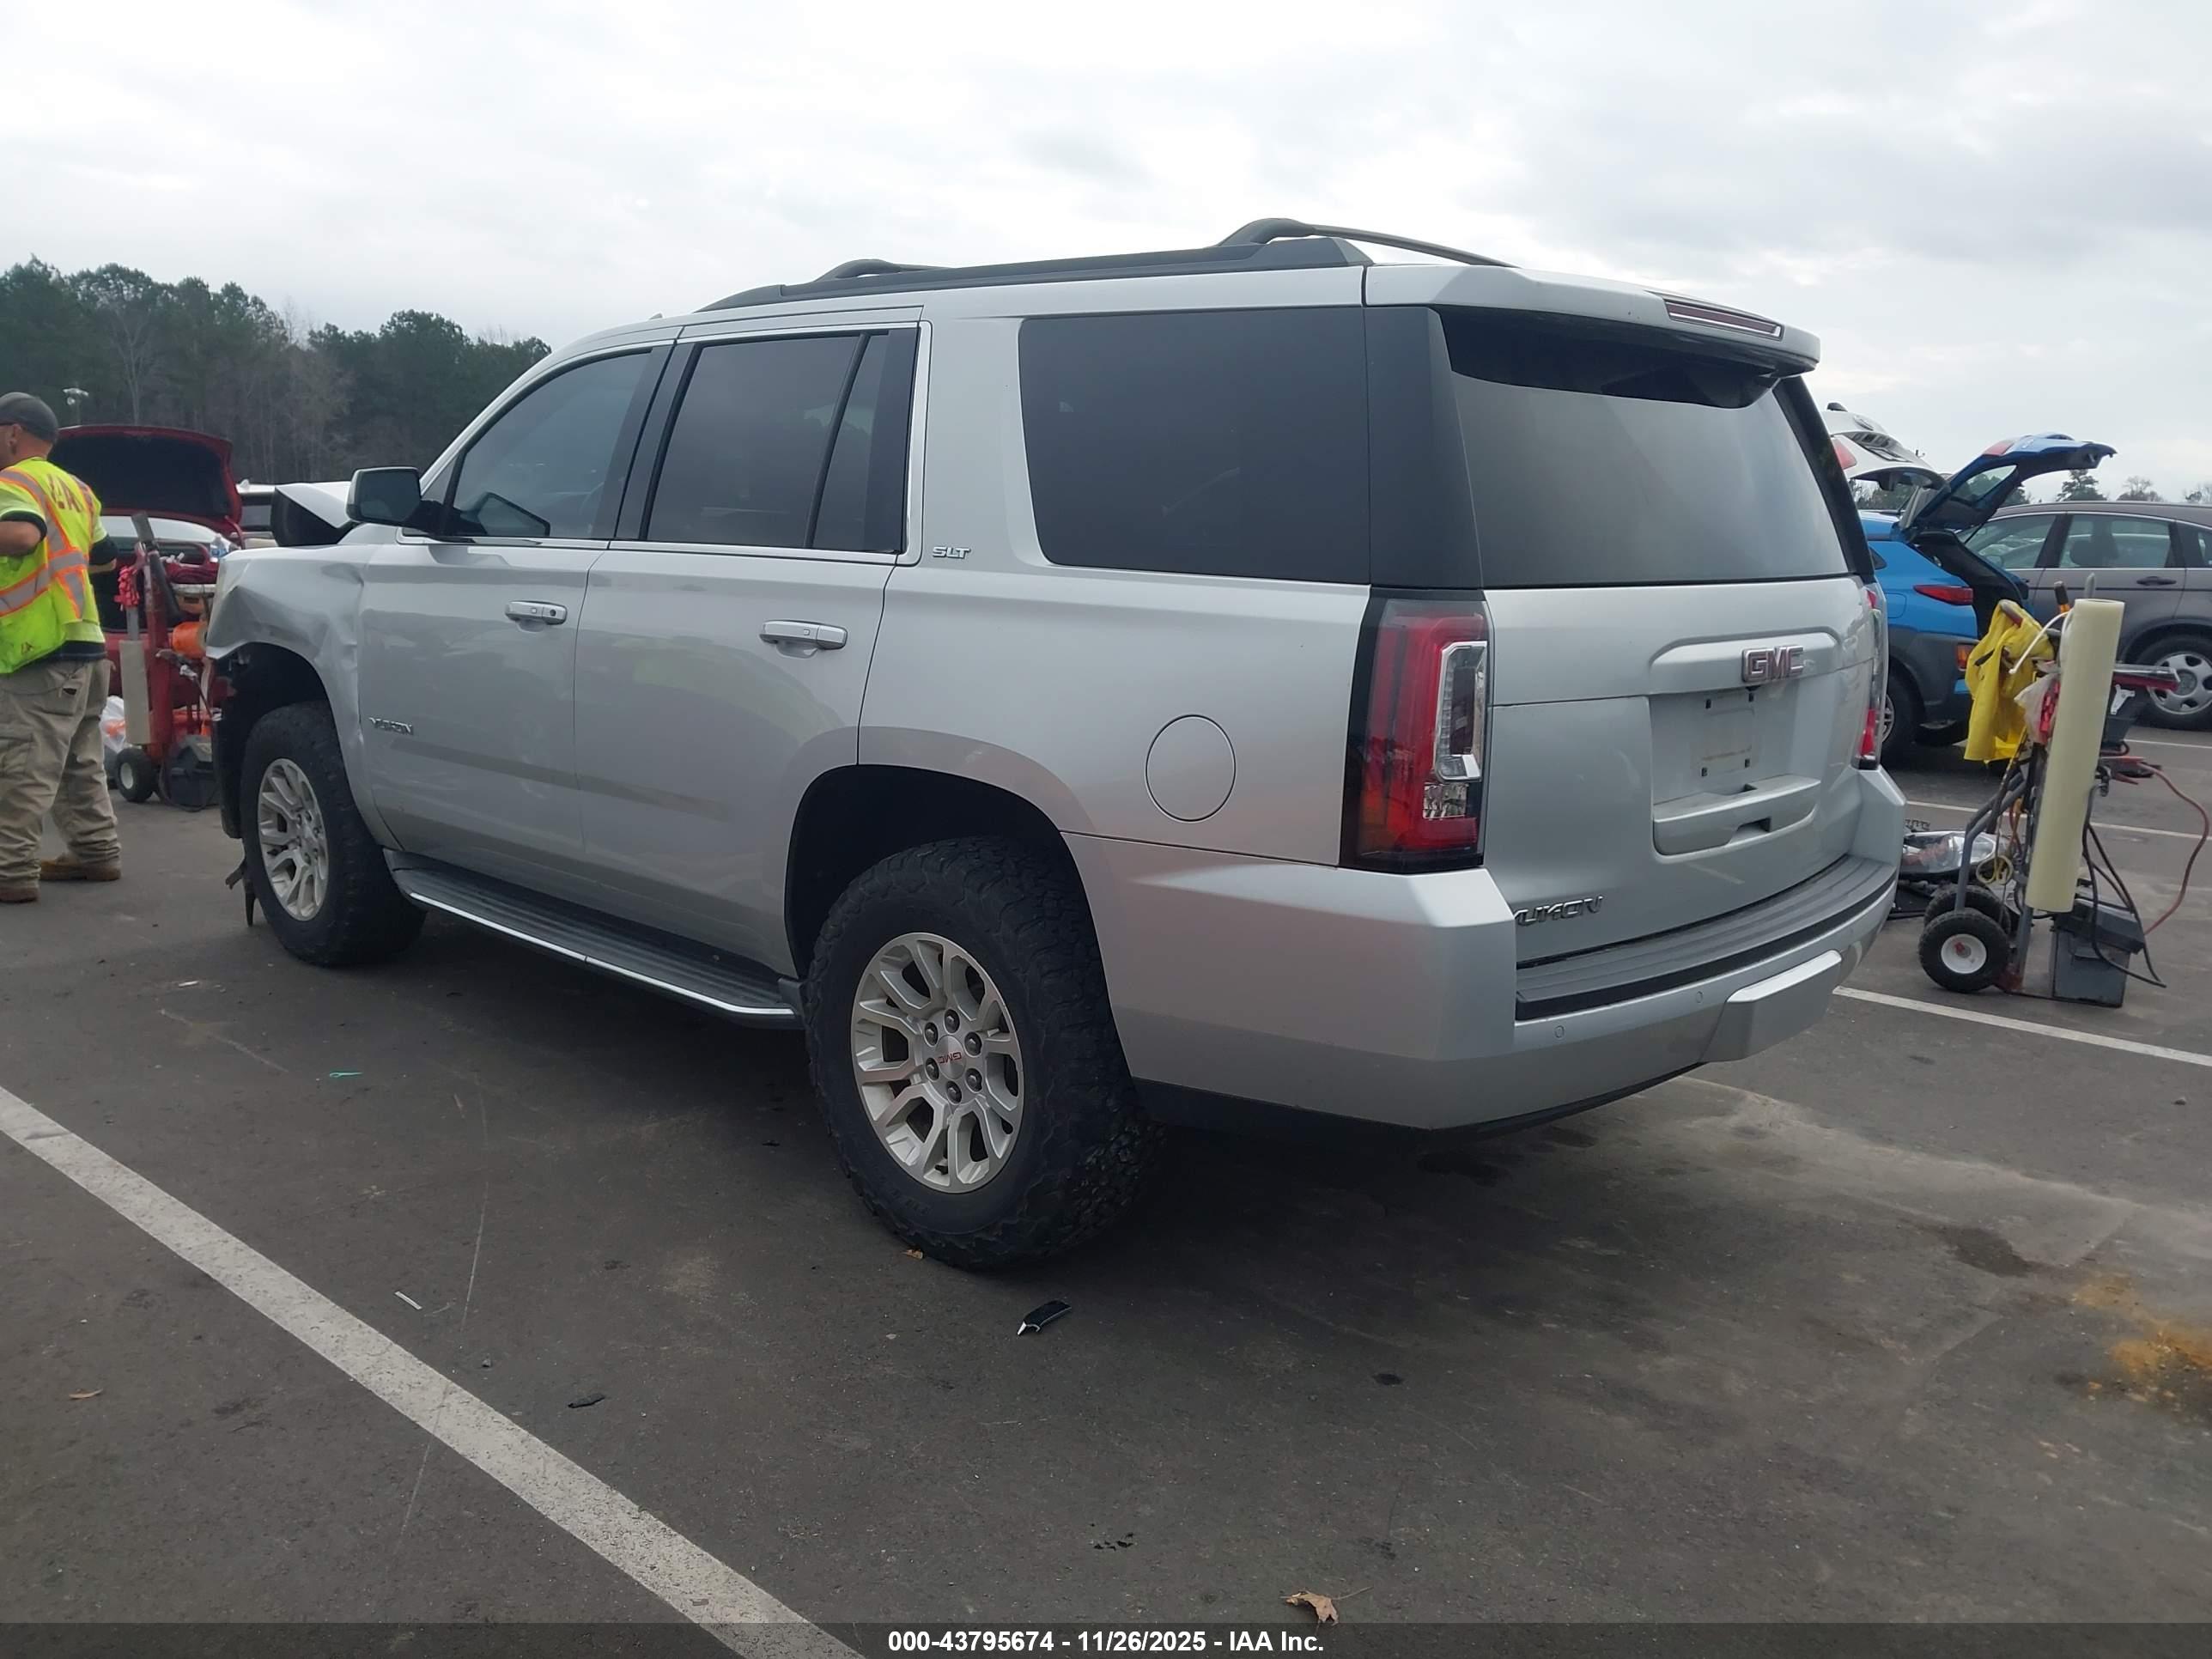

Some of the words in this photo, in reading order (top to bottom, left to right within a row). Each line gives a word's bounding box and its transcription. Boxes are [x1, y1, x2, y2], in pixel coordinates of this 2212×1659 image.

[932, 545, 971, 560] SLT
[1741, 645, 1804, 684] GMC
[938, 1051, 963, 1064] GMC
